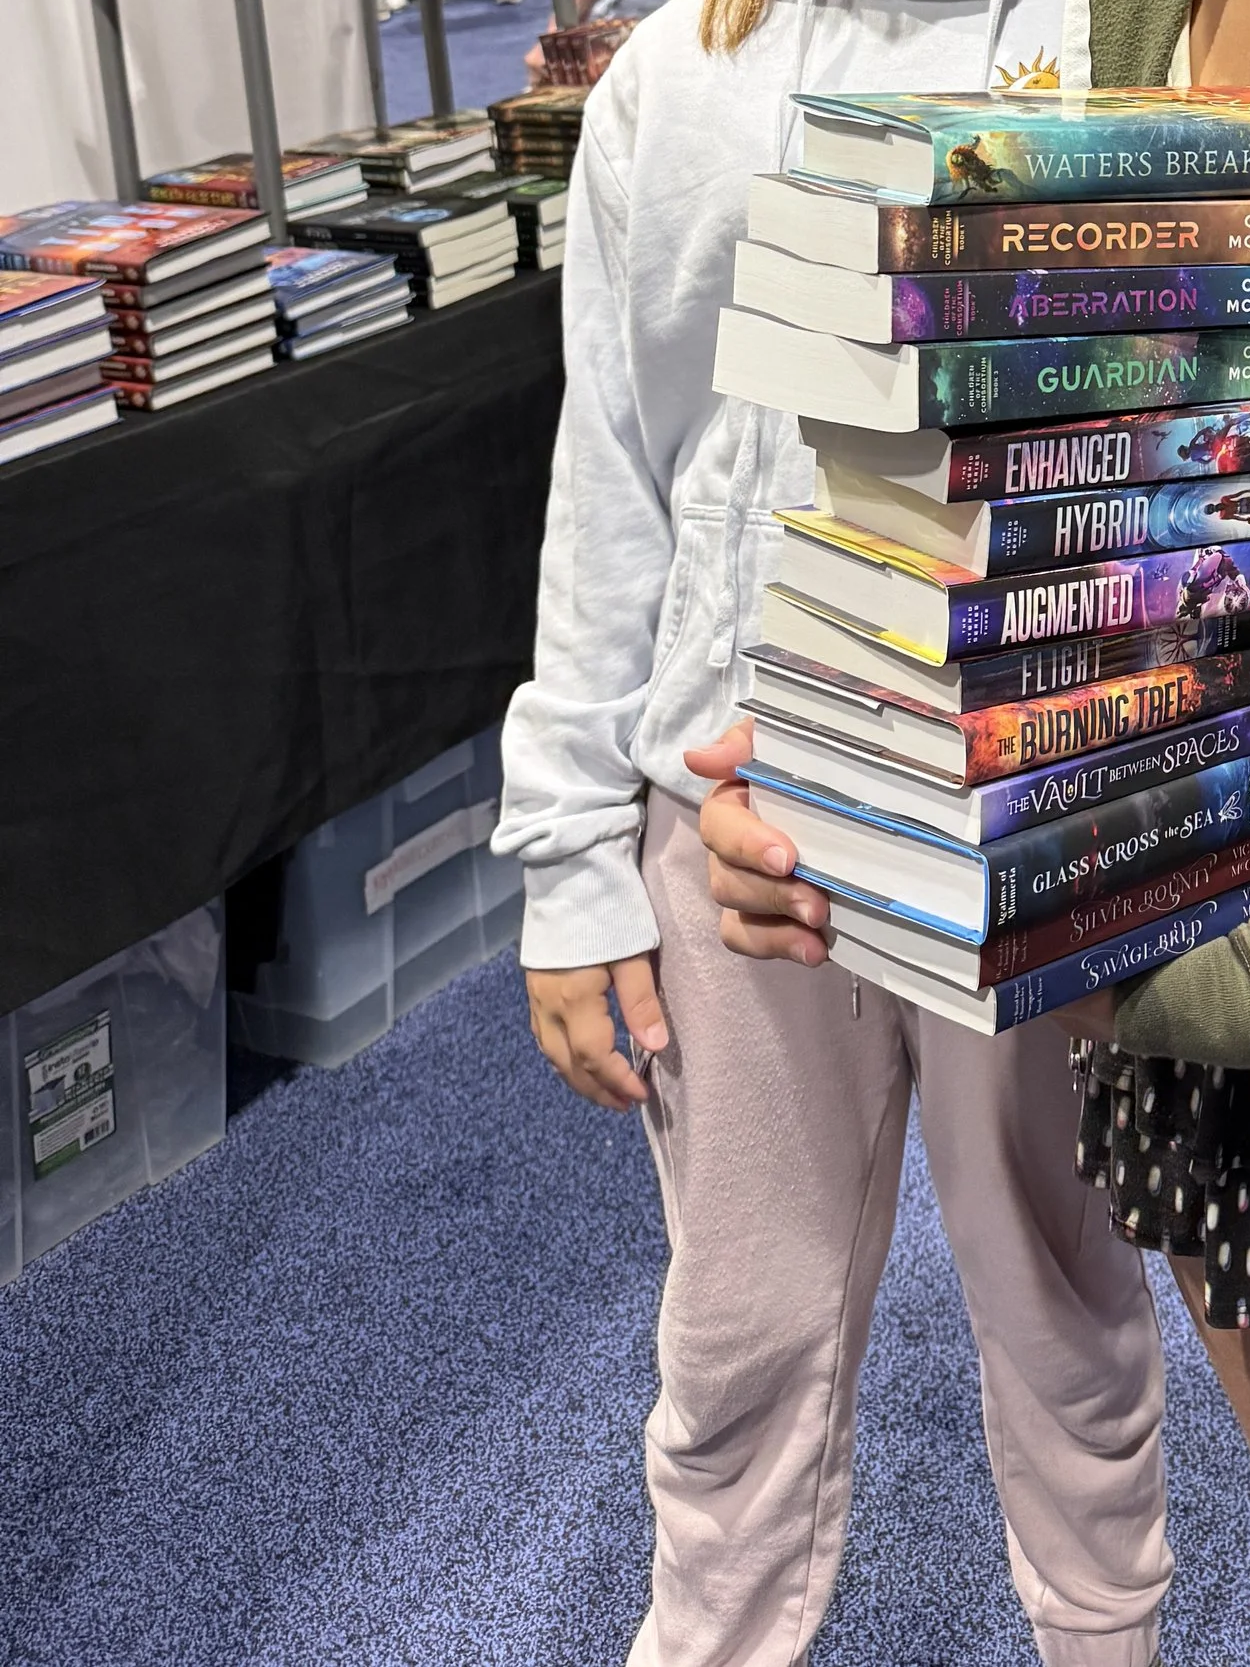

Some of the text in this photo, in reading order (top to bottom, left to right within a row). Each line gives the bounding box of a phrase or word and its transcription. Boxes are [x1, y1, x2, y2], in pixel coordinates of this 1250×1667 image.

[1024, 151, 1153, 181] WATER'S
[931, 217, 939, 259] CHILDREN
[944, 210, 953, 266] CONSORTIUM
[1003, 220, 1200, 253] RECORDER
[1008, 288, 1198, 320] ABERRATION
[1037, 356, 1199, 395] GUARDIAN
[1004, 431, 1132, 494] ENHANCED
[1054, 495, 1150, 557] HYBRID
[1000, 573, 1134, 645] AUGMENTED
[1021, 638, 1102, 696] FLIGHT
[997, 675, 1190, 767] THE BURNING TREE
[1007, 723, 1241, 816] THE VAULT BETWEEN SPACES
[1032, 811, 1215, 896] GLASS ACROSS the SEA
[998, 884, 1008, 926] Realms
[1070, 853, 1218, 943] SILVER BOUNTY
[1080, 942, 1153, 990] SAVAGE
